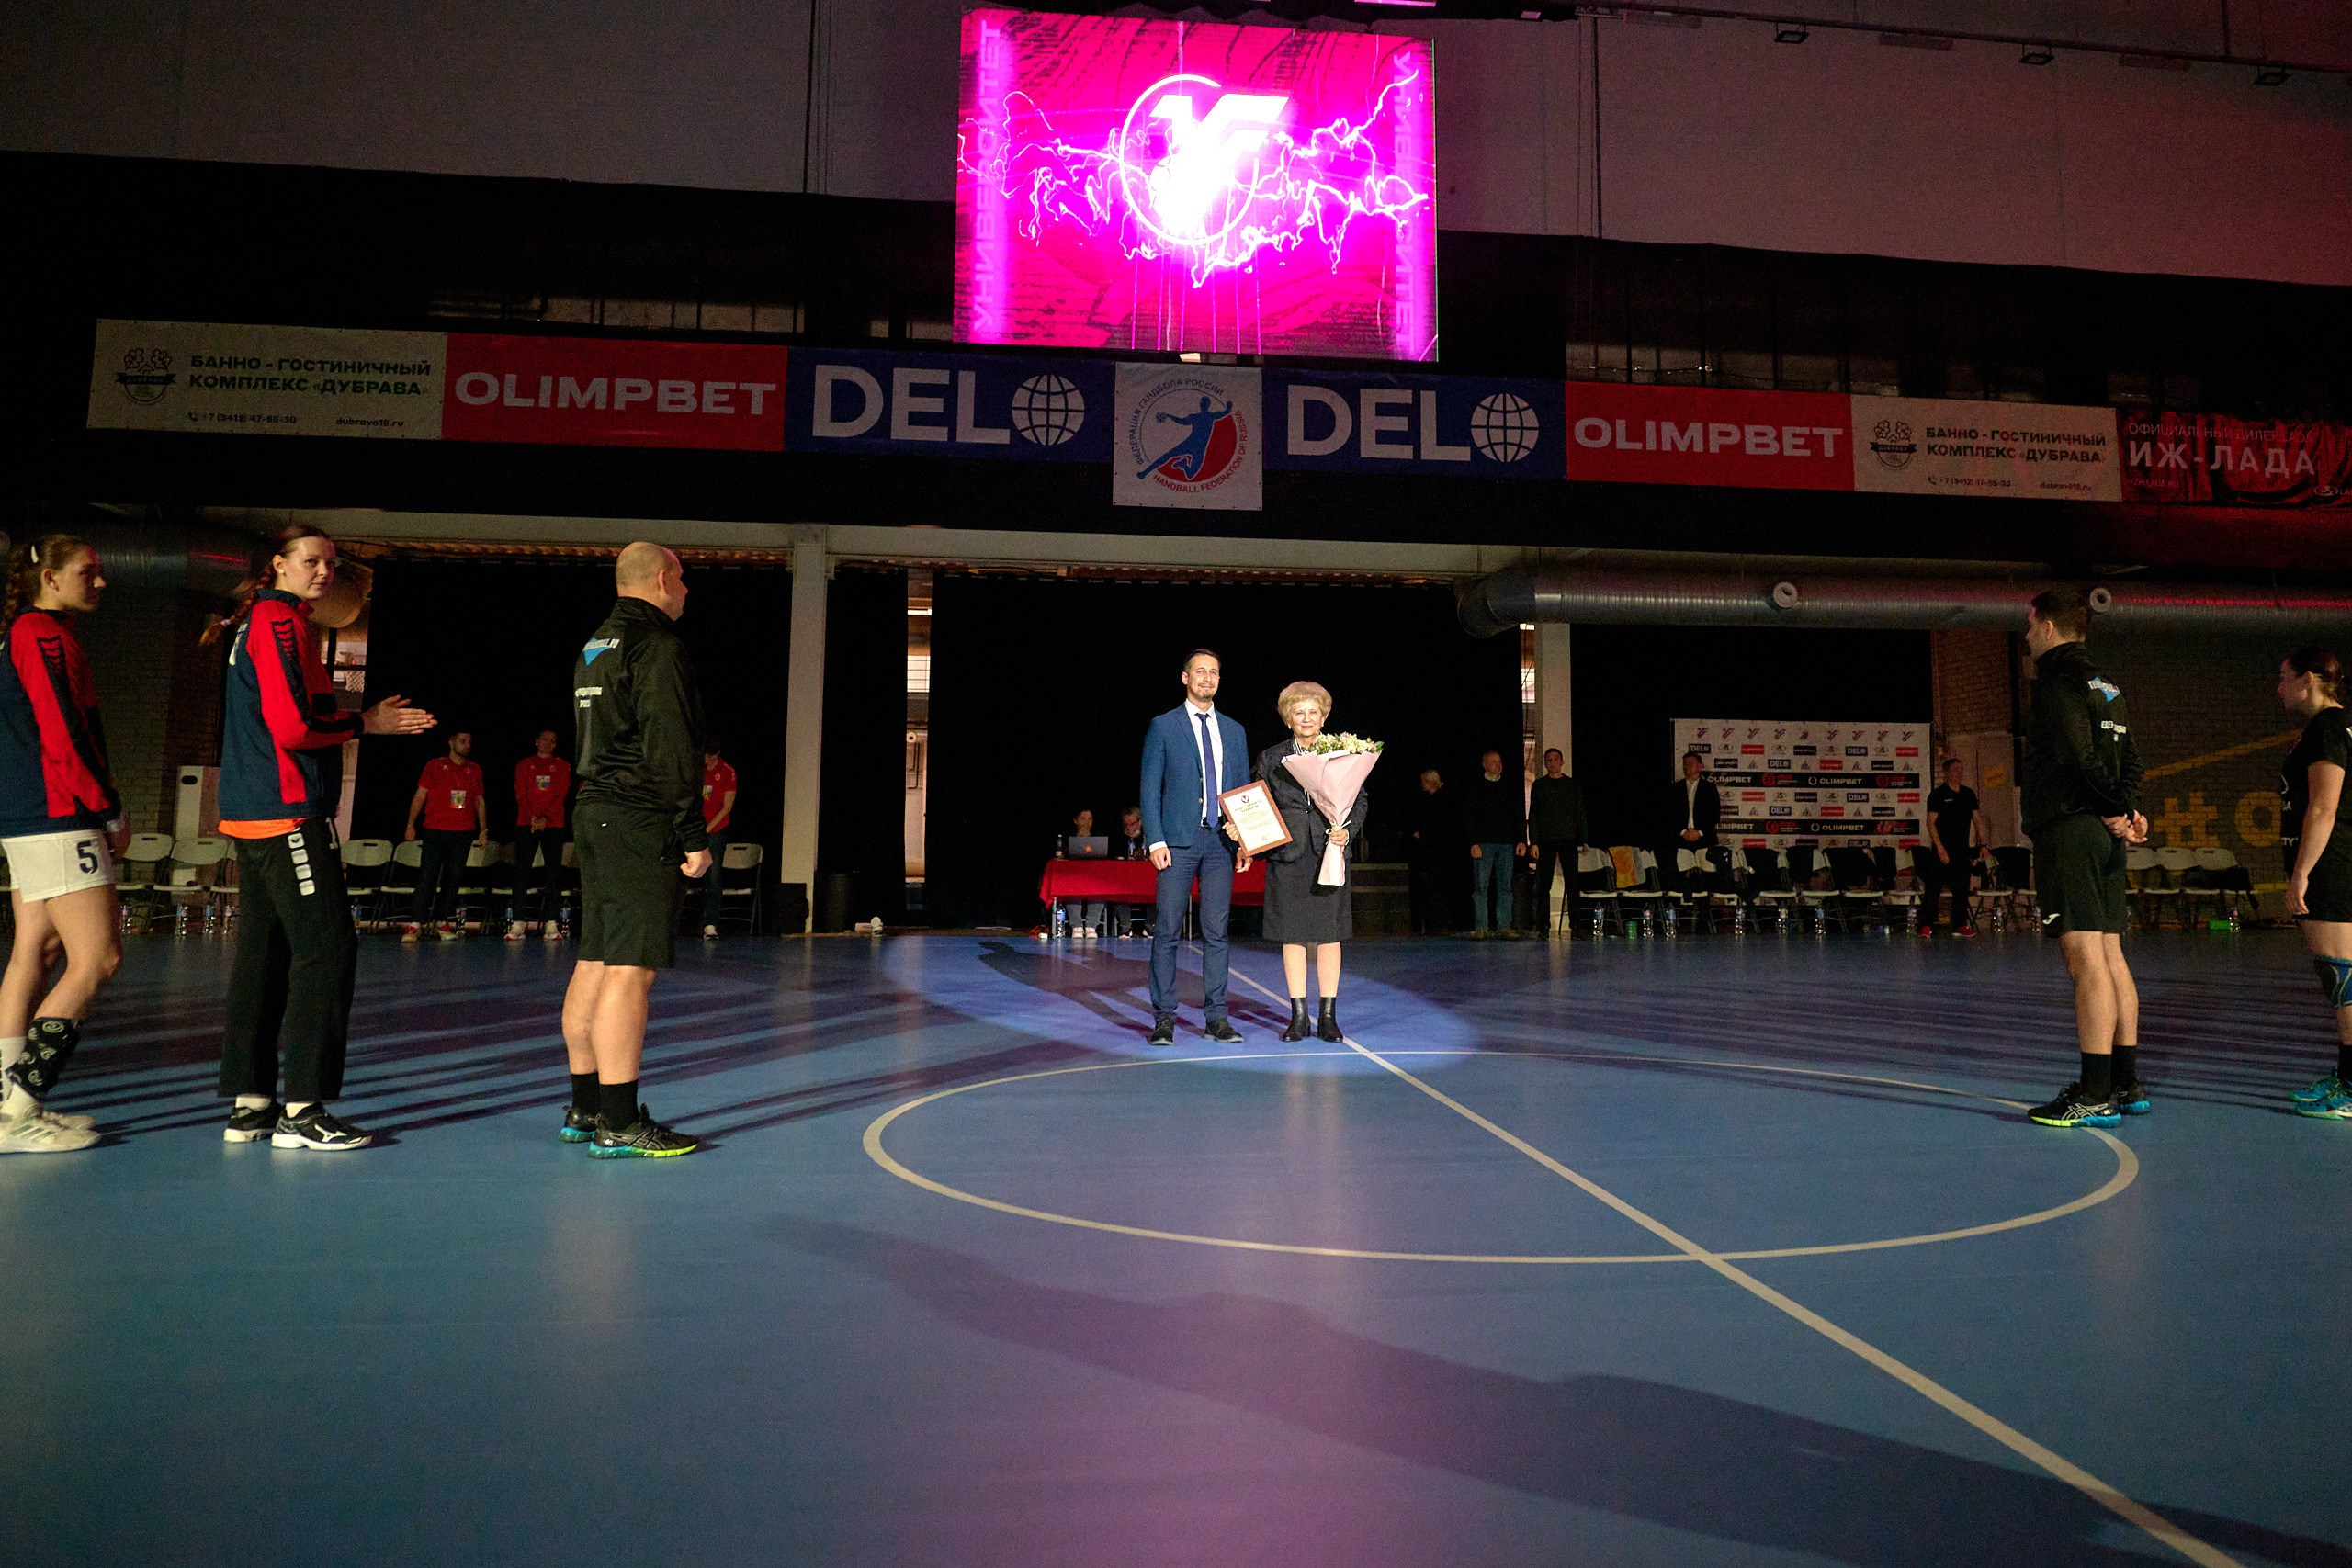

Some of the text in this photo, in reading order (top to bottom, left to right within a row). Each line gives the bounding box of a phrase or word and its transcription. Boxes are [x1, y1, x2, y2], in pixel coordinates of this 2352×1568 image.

[1393, 51, 1415, 354] УНИВЕСИТЕТ
[190, 355, 262, 370] БАННО
[277, 356, 432, 376] ГОСТИНИЧНЫЙ
[189, 375, 309, 392] КОМПЛЕКС
[454, 371, 777, 415] OLIMPBET
[1141, 378, 1183, 410] ГАНДБОЛА
[1184, 378, 1224, 397] РОССИИ
[1574, 417, 1844, 457] OLIMPBET
[1926, 427, 1979, 440] БАННО
[1991, 430, 2107, 446] ГОСТИНИЧНЫЙ
[1153, 474, 1200, 493] HANDBALL
[1200, 455, 1242, 492] FEDERATION
[1235, 410, 1249, 443] RUSSIA
[1928, 444, 2017, 458] КОМПЛЕКС
[1818, 776, 1863, 785] OLIMPBET
[1822, 823, 1865, 832] OLIMPBET
[77, 840, 99, 874] 5
